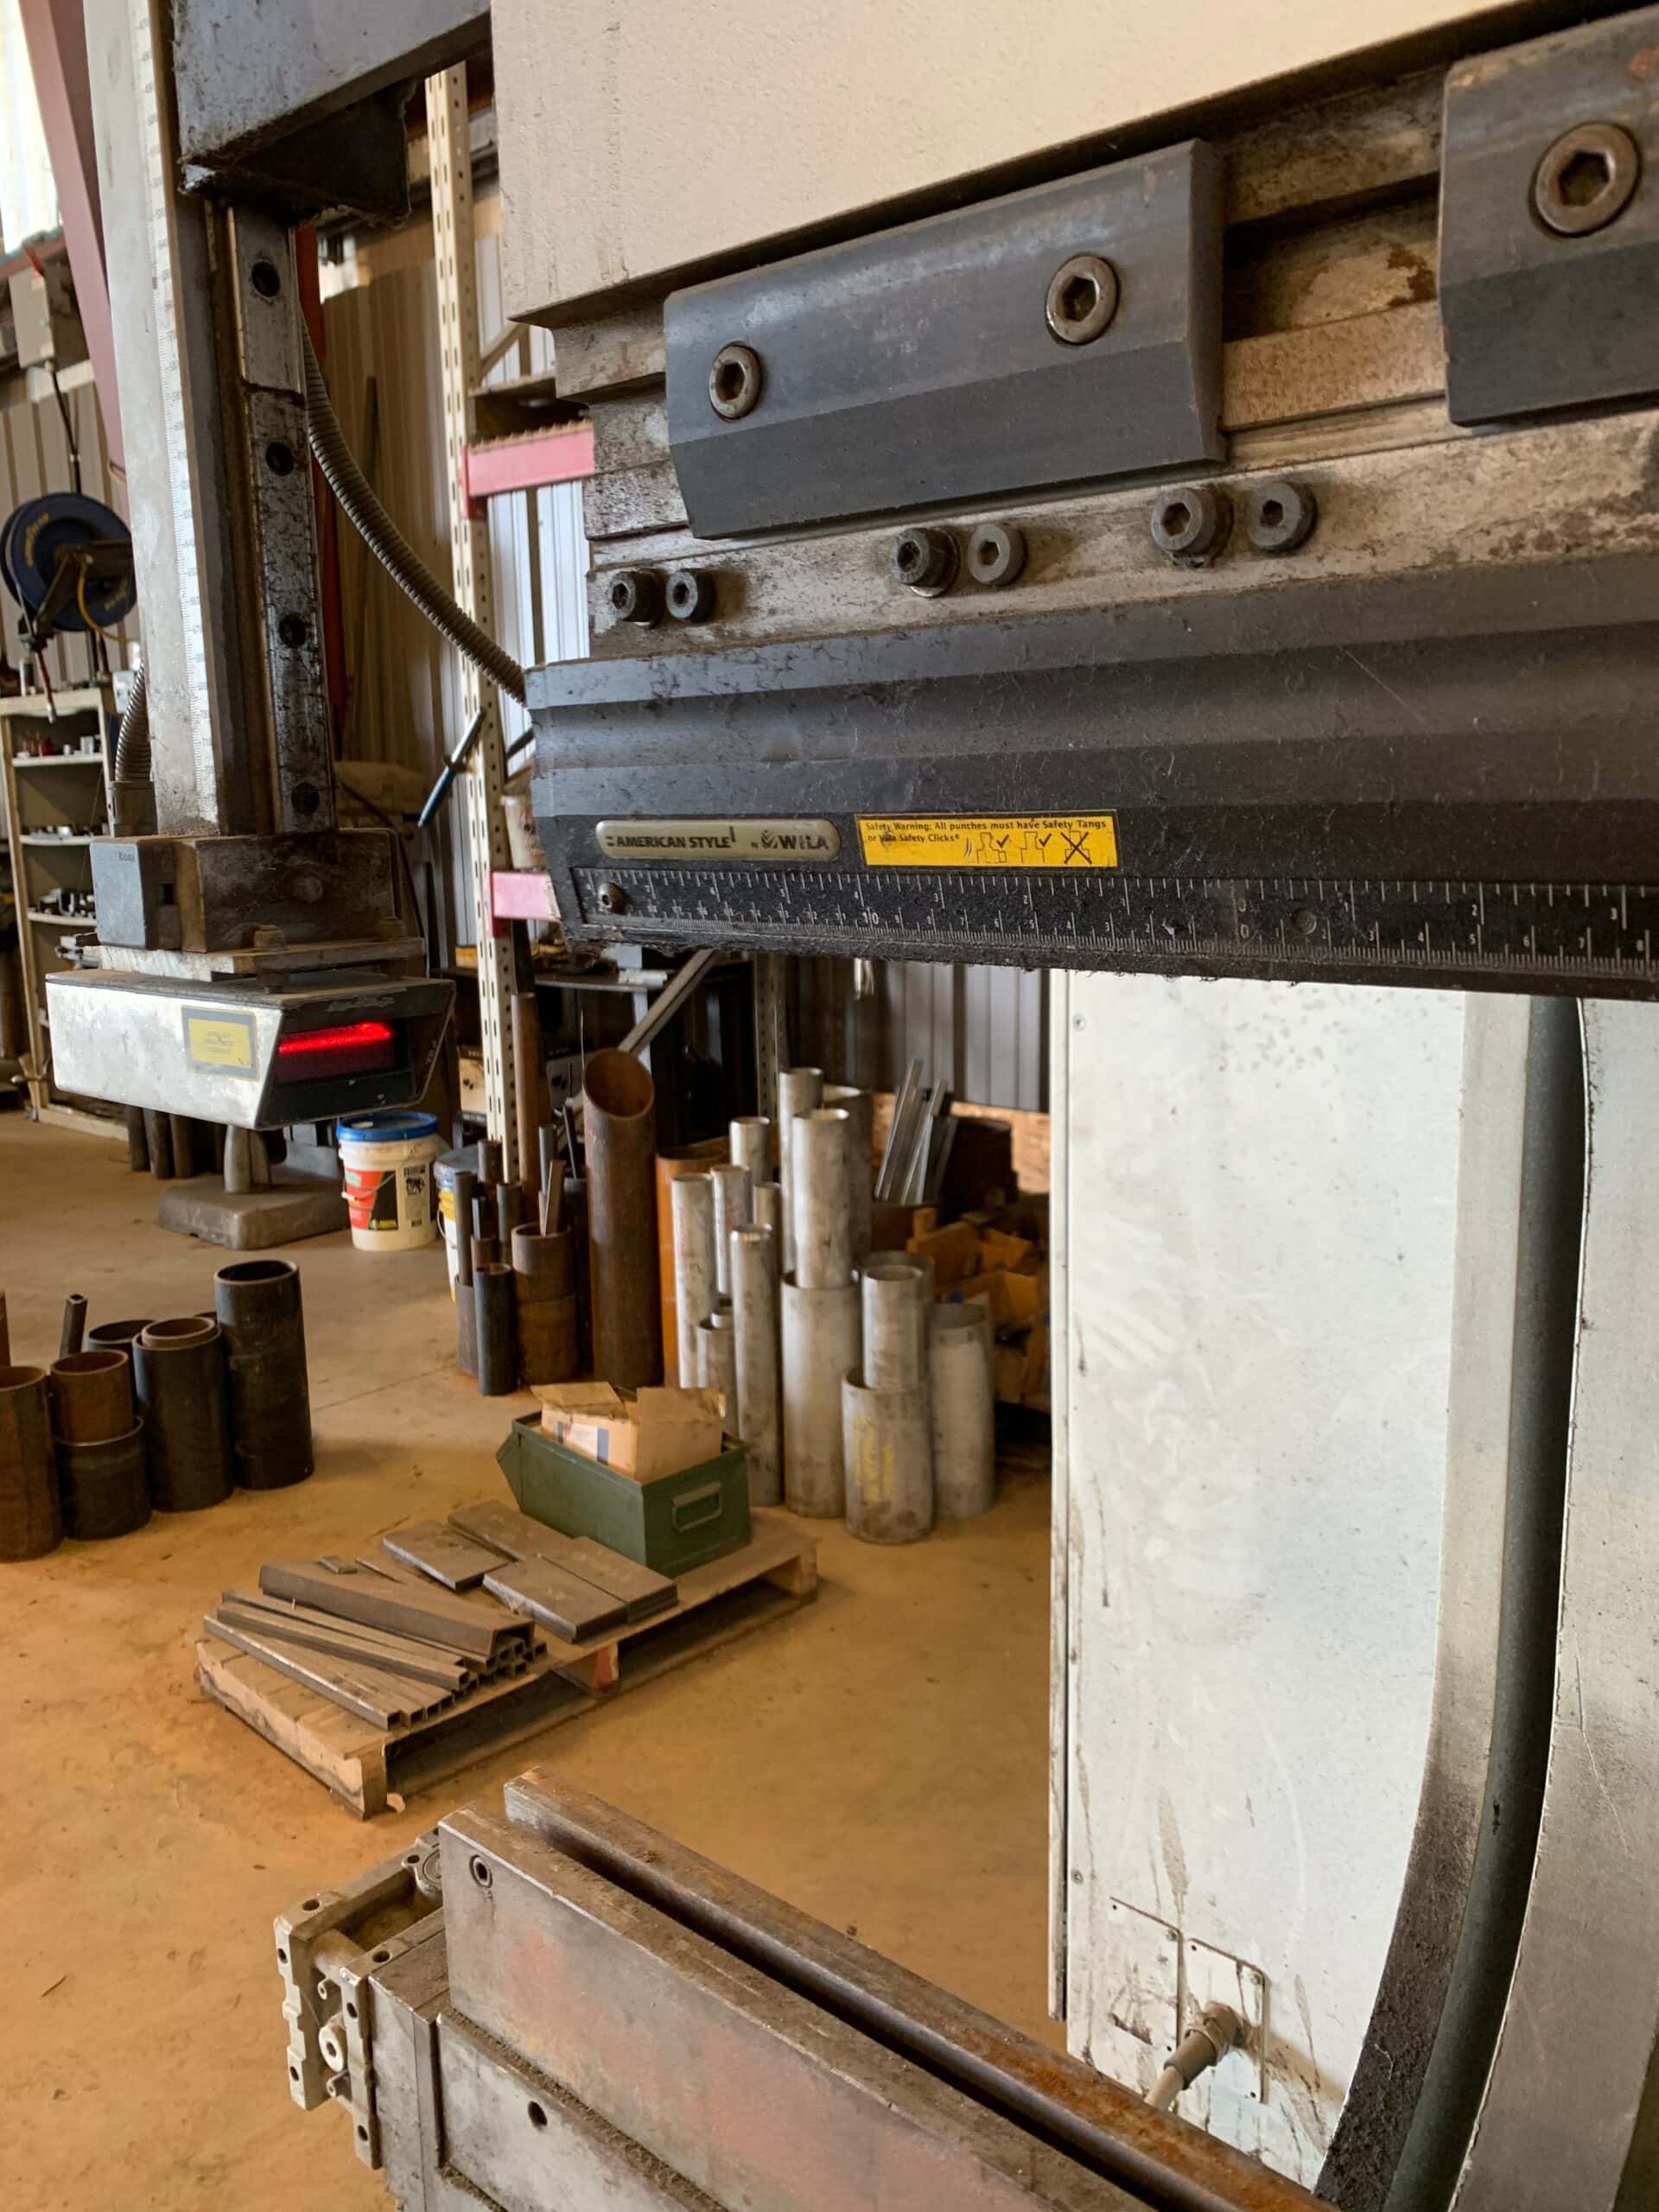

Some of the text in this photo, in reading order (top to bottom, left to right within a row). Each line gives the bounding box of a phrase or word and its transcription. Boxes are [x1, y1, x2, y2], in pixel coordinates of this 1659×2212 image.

[866, 822, 891, 831] Safety
[894, 822, 932, 832] Warning:
[935, 822, 947, 830] All
[950, 822, 988, 831] punches
[1017, 821, 1040, 830] have
[1043, 820, 1073, 830] Safety
[1078, 820, 1107, 830] Tangs
[617, 836, 687, 849] AMERICAN
[689, 836, 732, 849] STYLE
[779, 835, 830, 850] WILA
[899, 834, 925, 843] Safety
[933, 893, 939, 903] 3
[1022, 894, 1029, 905] 2
[1471, 904, 1478, 917] 2
[1610, 907, 1618, 920] 3
[862, 912, 880, 925] 10
[894, 914, 900, 924] 9
[960, 917, 965, 926] 7
[994, 918, 1000, 928] 6
[1028, 920, 1035, 929] 5
[1066, 920, 1071, 930] 4
[1104, 921, 1110, 932] 3
[1145, 923, 1151, 933] 2
[1240, 924, 1249, 938] 0
[1321, 929, 1327, 940] 2
[1368, 930, 1375, 942] 3
[1417, 931, 1424, 943] 4
[1469, 933, 1477, 945] 5
[1522, 935, 1530, 947] 6
[1579, 937, 1586, 950] 7
[1636, 939, 1644, 952] 8
